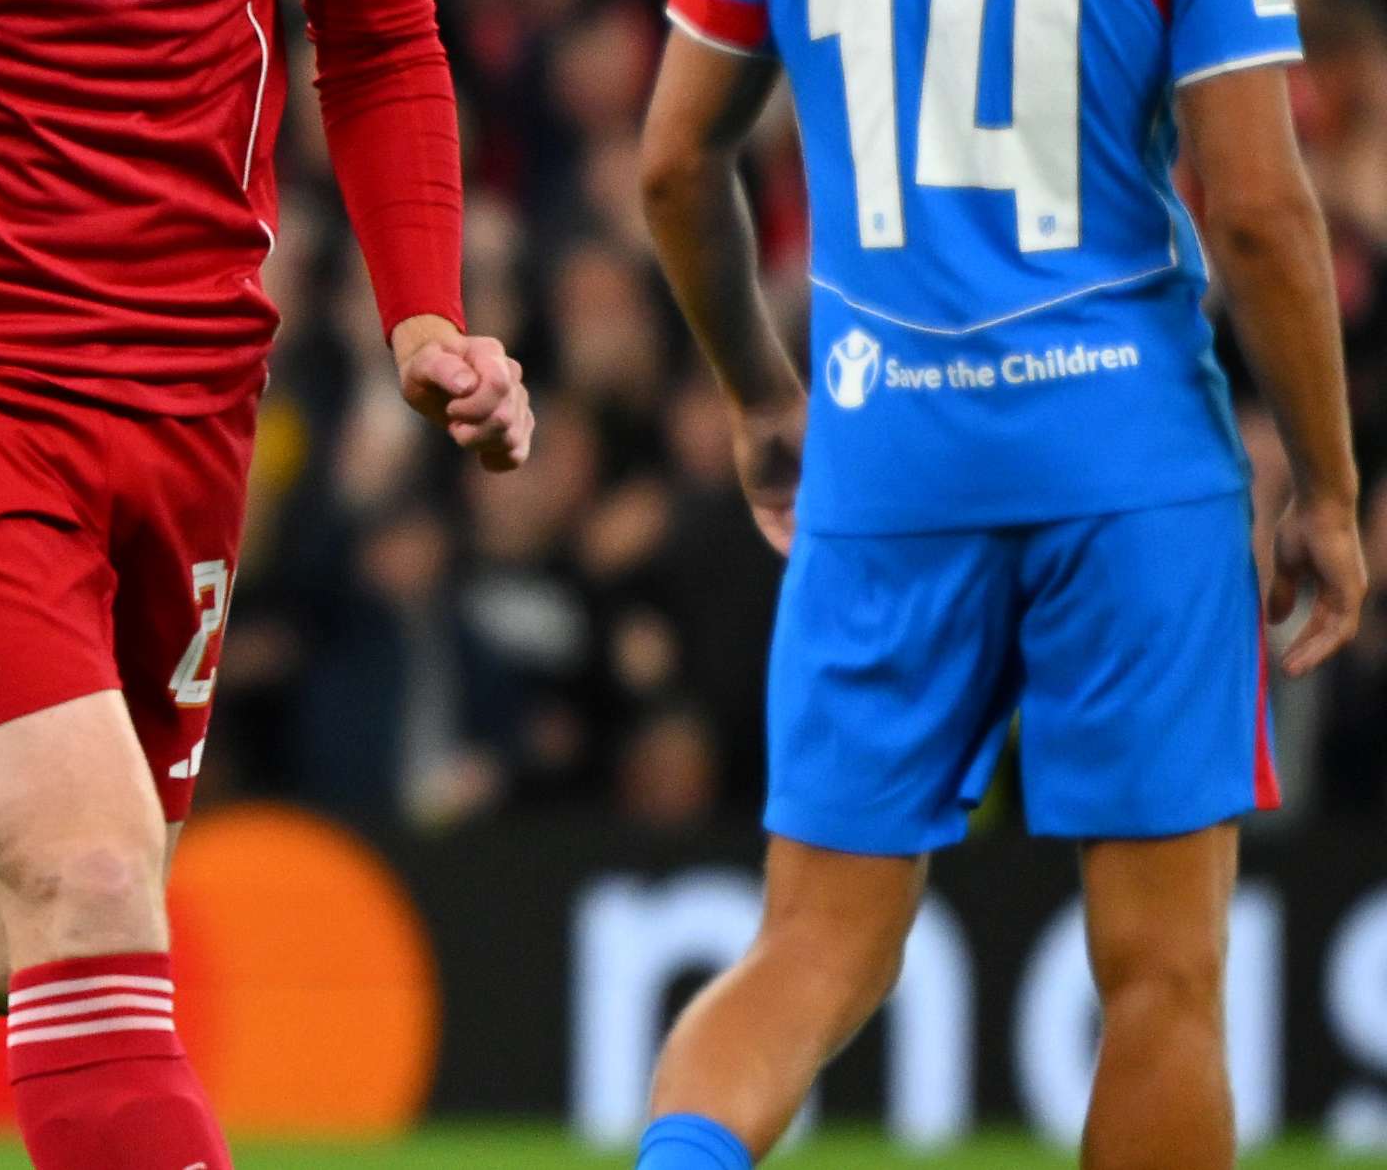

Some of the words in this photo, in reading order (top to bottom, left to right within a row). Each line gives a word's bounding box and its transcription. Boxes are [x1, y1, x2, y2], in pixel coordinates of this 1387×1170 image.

[884, 358, 941, 389] Save
[946, 361, 995, 388] the
[1001, 345, 1139, 384] Children
